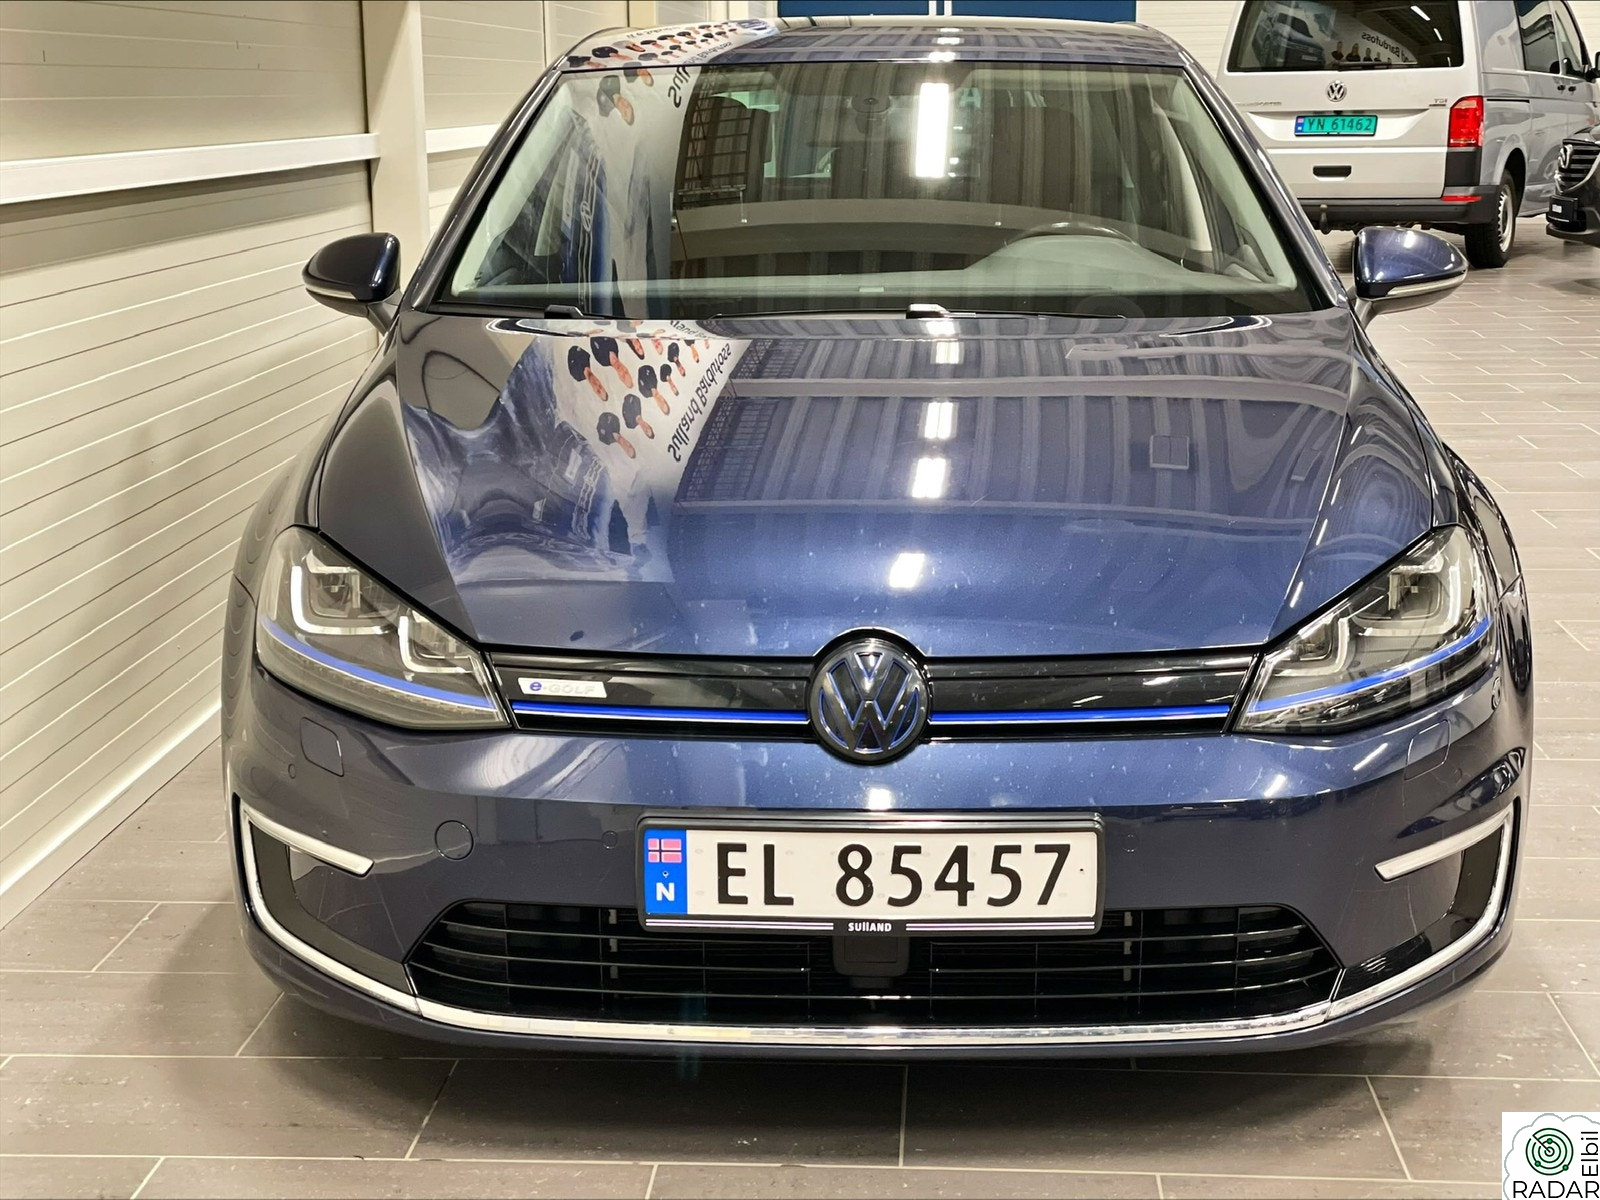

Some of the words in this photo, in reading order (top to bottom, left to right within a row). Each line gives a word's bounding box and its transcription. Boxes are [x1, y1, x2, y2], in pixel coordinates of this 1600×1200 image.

[1308, 118, 1326, 131] YN
[1331, 117, 1373, 131] 61462
[716, 843, 794, 906] EL
[835, 843, 1071, 907] 85457
[656, 882, 675, 902] N
